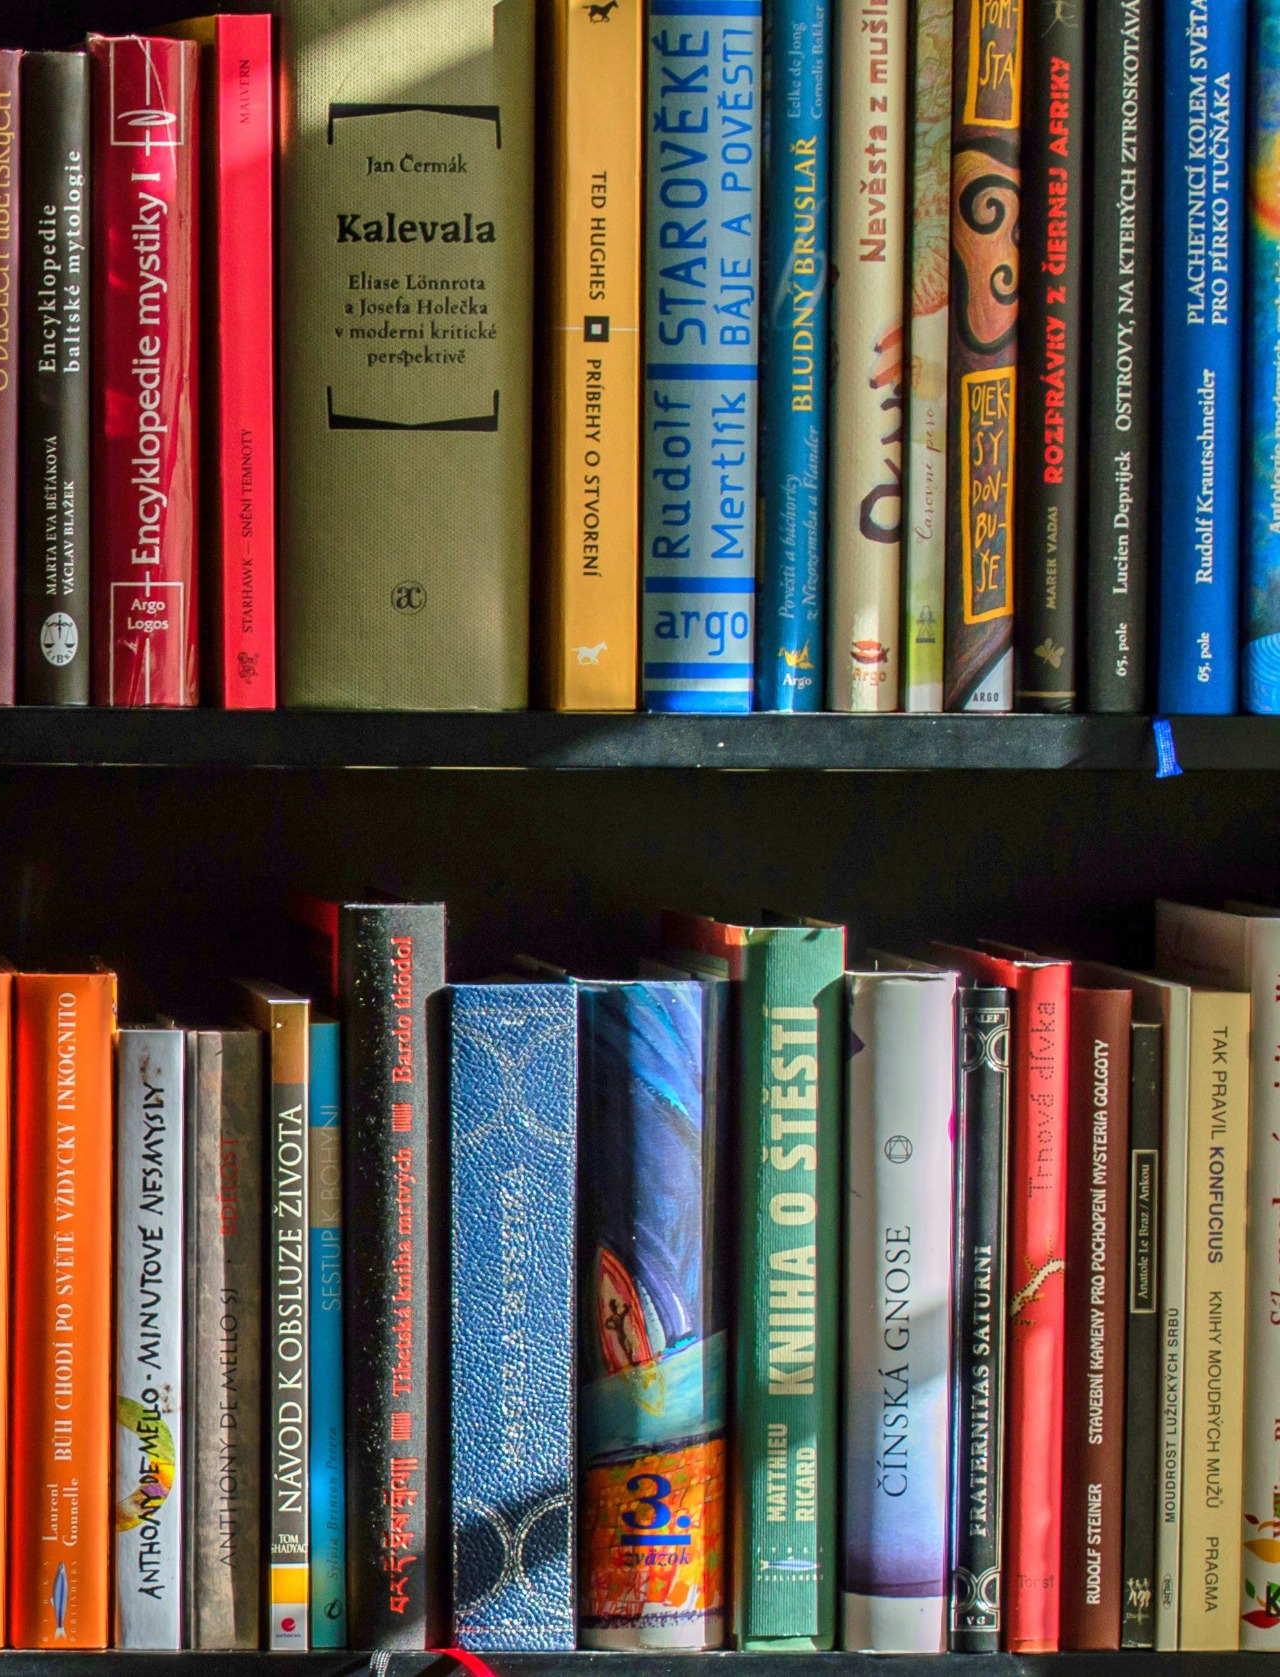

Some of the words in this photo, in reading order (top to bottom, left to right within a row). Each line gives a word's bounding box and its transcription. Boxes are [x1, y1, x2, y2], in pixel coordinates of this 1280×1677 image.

[717, 29, 753, 192] POVĚSTI
[1048, 57, 1071, 157] AFRIKY
[1208, 72, 1231, 191] TUČŇÁKA
[131, 173, 160, 181] I
[367, 160, 396, 175] Jan
[400, 153, 467, 174] Čermák
[591, 171, 605, 208] TED
[652, 29, 711, 346] STAROVĚKÉ
[791, 136, 817, 275] BRUSLAŘ
[63, 150, 85, 274] mytologie
[336, 214, 496, 244] Kalevala
[723, 213, 753, 236] A
[1041, 167, 1069, 276] ČIERNEJ
[1209, 198, 1229, 273] PÍRKO
[38, 205, 61, 372] Encyklopedie
[131, 192, 167, 325] mystiky
[591, 216, 606, 300] HUGHES
[716, 257, 755, 344] BÁJE
[1046, 286, 1066, 305] Z
[1211, 278, 1228, 325] PRO
[62, 284, 81, 372] baltské
[791, 284, 815, 411] BLUDNÝ
[584, 360, 601, 442] PRÍBEHY
[1040, 315, 1066, 483] ROZPRÁVKY
[1196, 368, 1216, 513] Krautschneider
[131, 336, 168, 564] Encyklopedie
[585, 450, 600, 467] O
[652, 390, 691, 558] Rudolf
[710, 393, 746, 558] Mertlík
[583, 475, 601, 577] STVORENÍ
[1194, 519, 1215, 583] Rudolf
[127, 619, 170, 631] Logos
[129, 600, 165, 613] Argo
[655, 611, 749, 654] argo
[392, 936, 414, 1008] thödol
[392, 1014, 413, 1083] Bardo
[760, 1004, 818, 1171] ŠTĚSTÍ
[273, 1104, 304, 1218] ŽIVOTA
[390, 1148, 417, 1235] mrtvých
[769, 1191, 818, 1225] O
[278, 1228, 303, 1362] OBSLUZE
[391, 1242, 413, 1302] kniha
[885, 1226, 911, 1350] GNOSE
[389, 1308, 414, 1396] Tibetská
[767, 1248, 815, 1394] KNIHA
[279, 1369, 301, 1390] K
[1162, 1352, 1180, 1436] LUŽICKÝCH
[273, 1401, 302, 1511] NÁVOD
[767, 1423, 787, 1521] MATTHIEU
[876, 1364, 909, 1497] ČÍNSKÁ
[970, 1365, 989, 1537] FRATERNITAS
[796, 1447, 815, 1521] RICARD
[1087, 1484, 1102, 1545] STEINER
[1164, 1441, 1177, 1522] MOUDROST
[1087, 1549, 1102, 1604] RUDOLF
